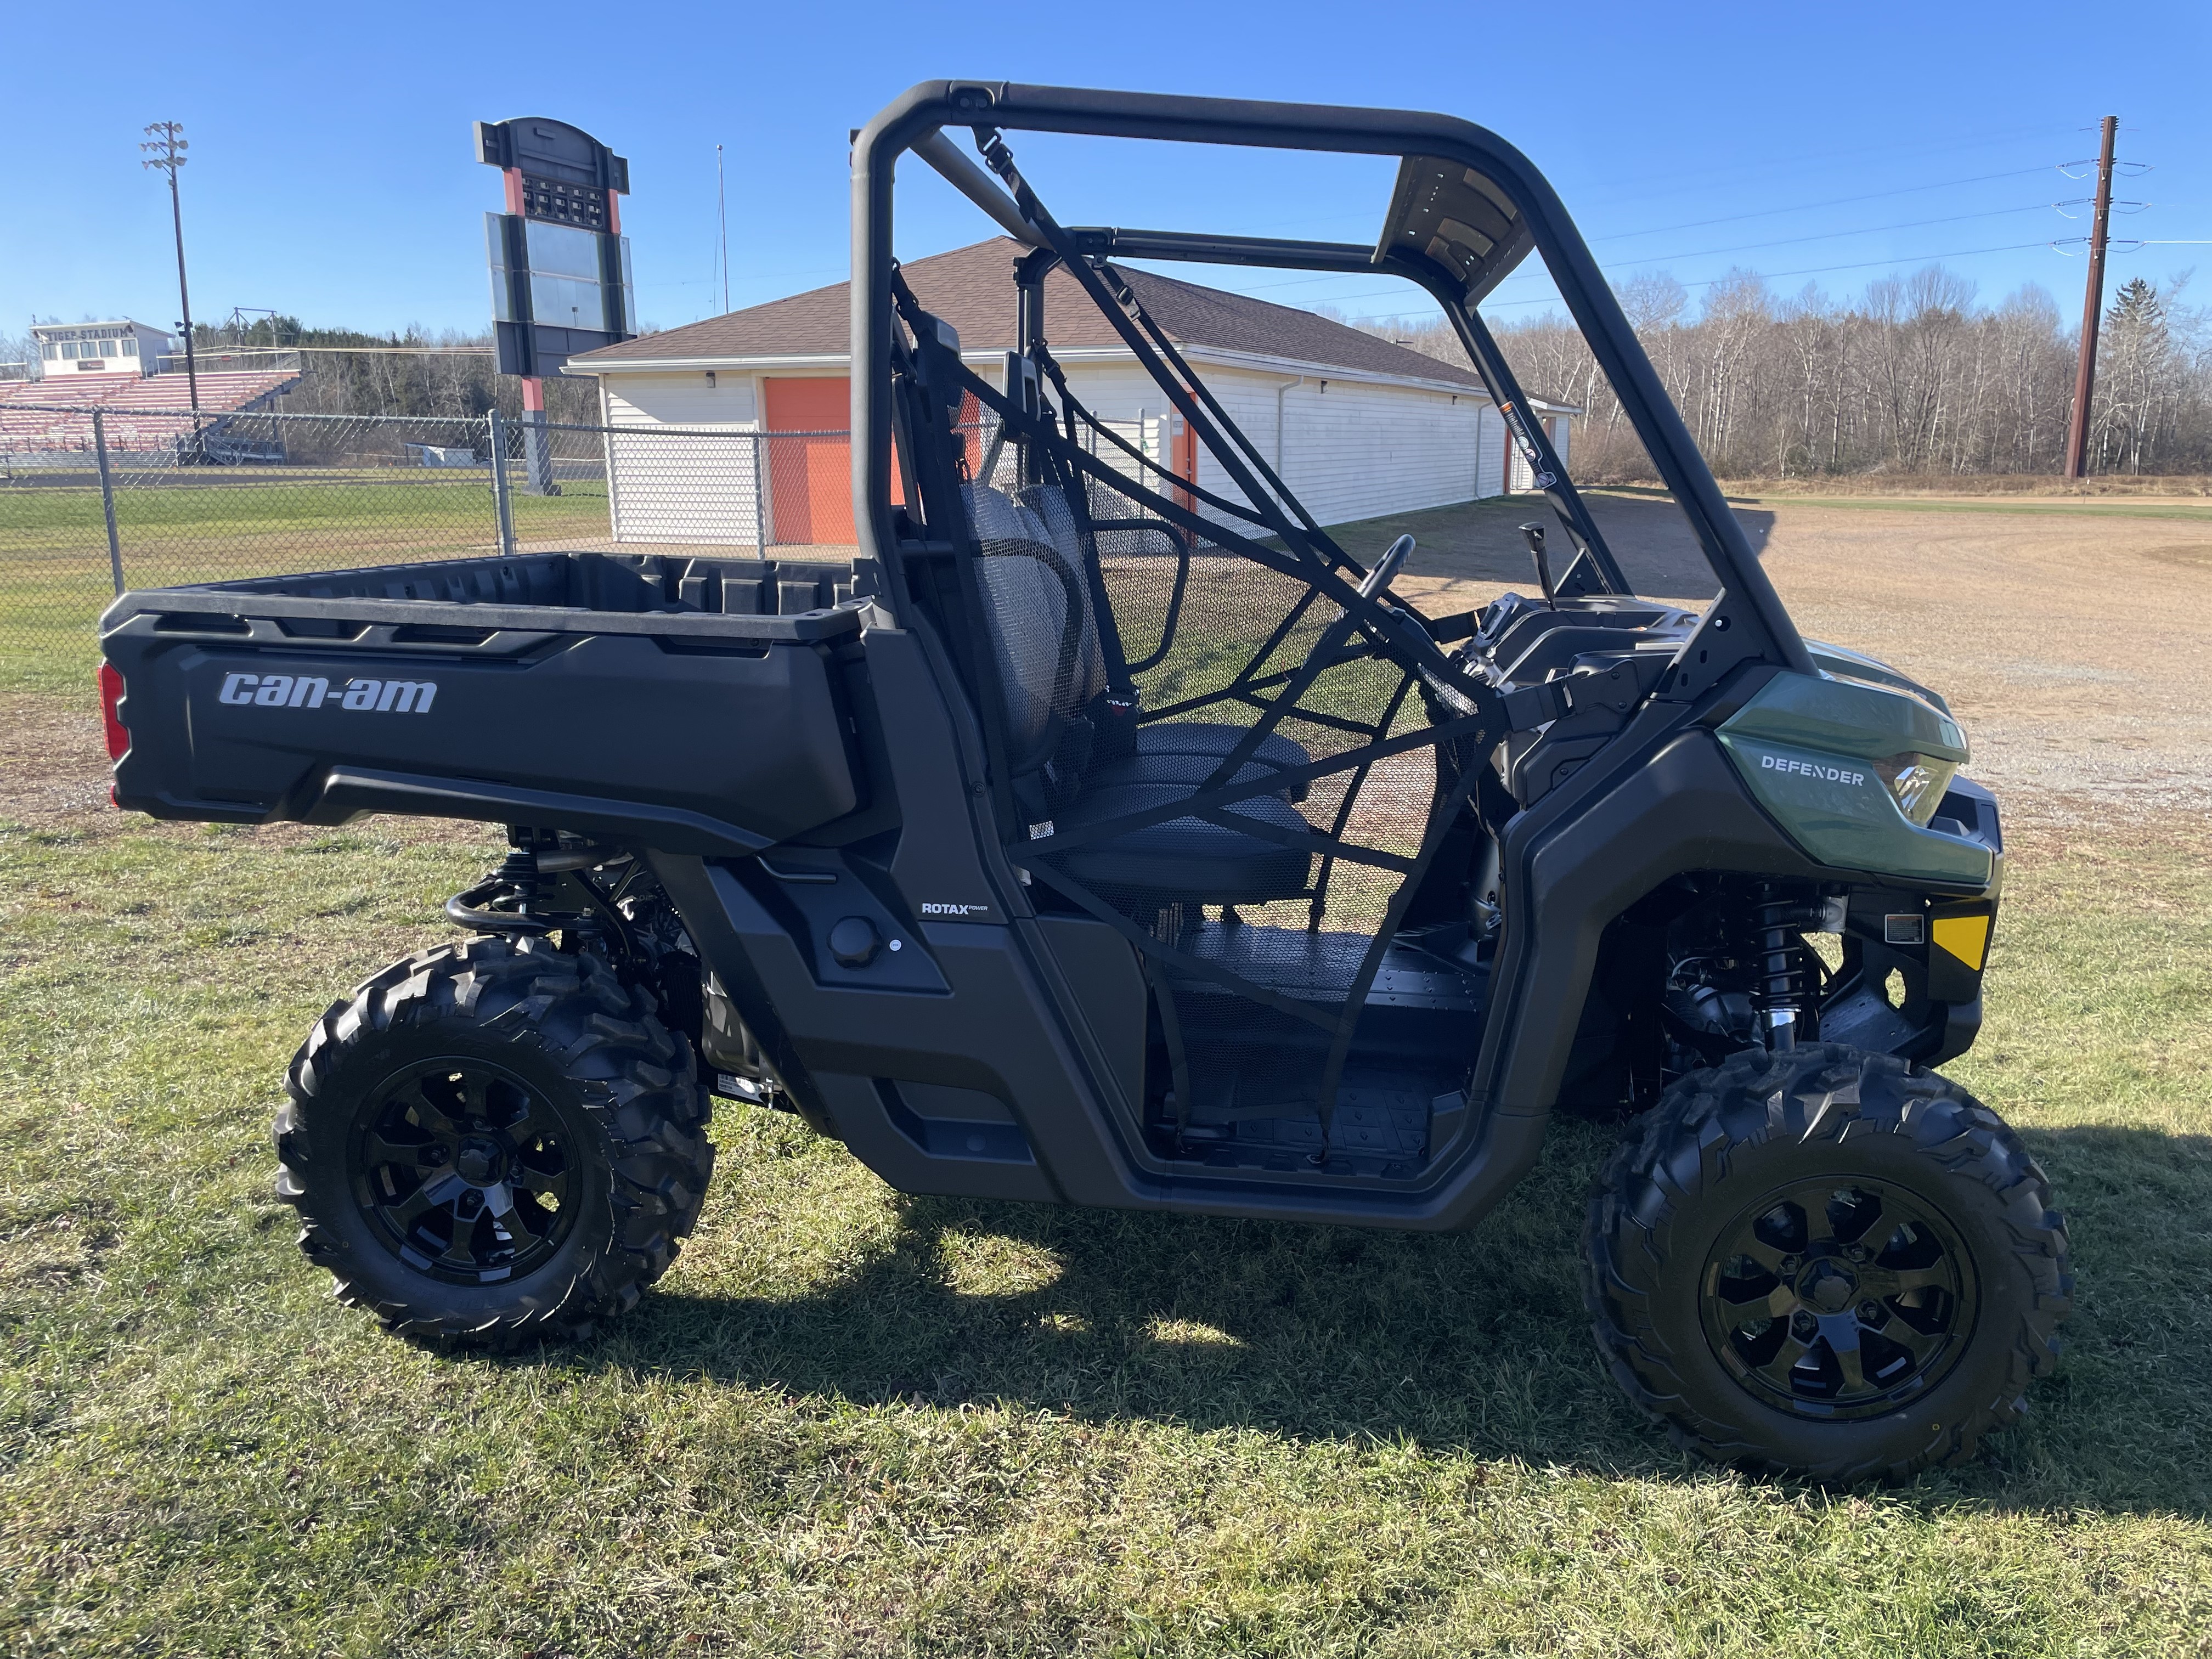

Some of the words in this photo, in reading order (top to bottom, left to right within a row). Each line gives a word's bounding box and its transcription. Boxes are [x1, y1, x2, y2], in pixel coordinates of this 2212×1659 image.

[81, 328, 128, 340] STADIUM
[219, 673, 437, 713] can-am
[1762, 755, 1865, 786] DEFENDER
[922, 903, 969, 915] ROTAX
